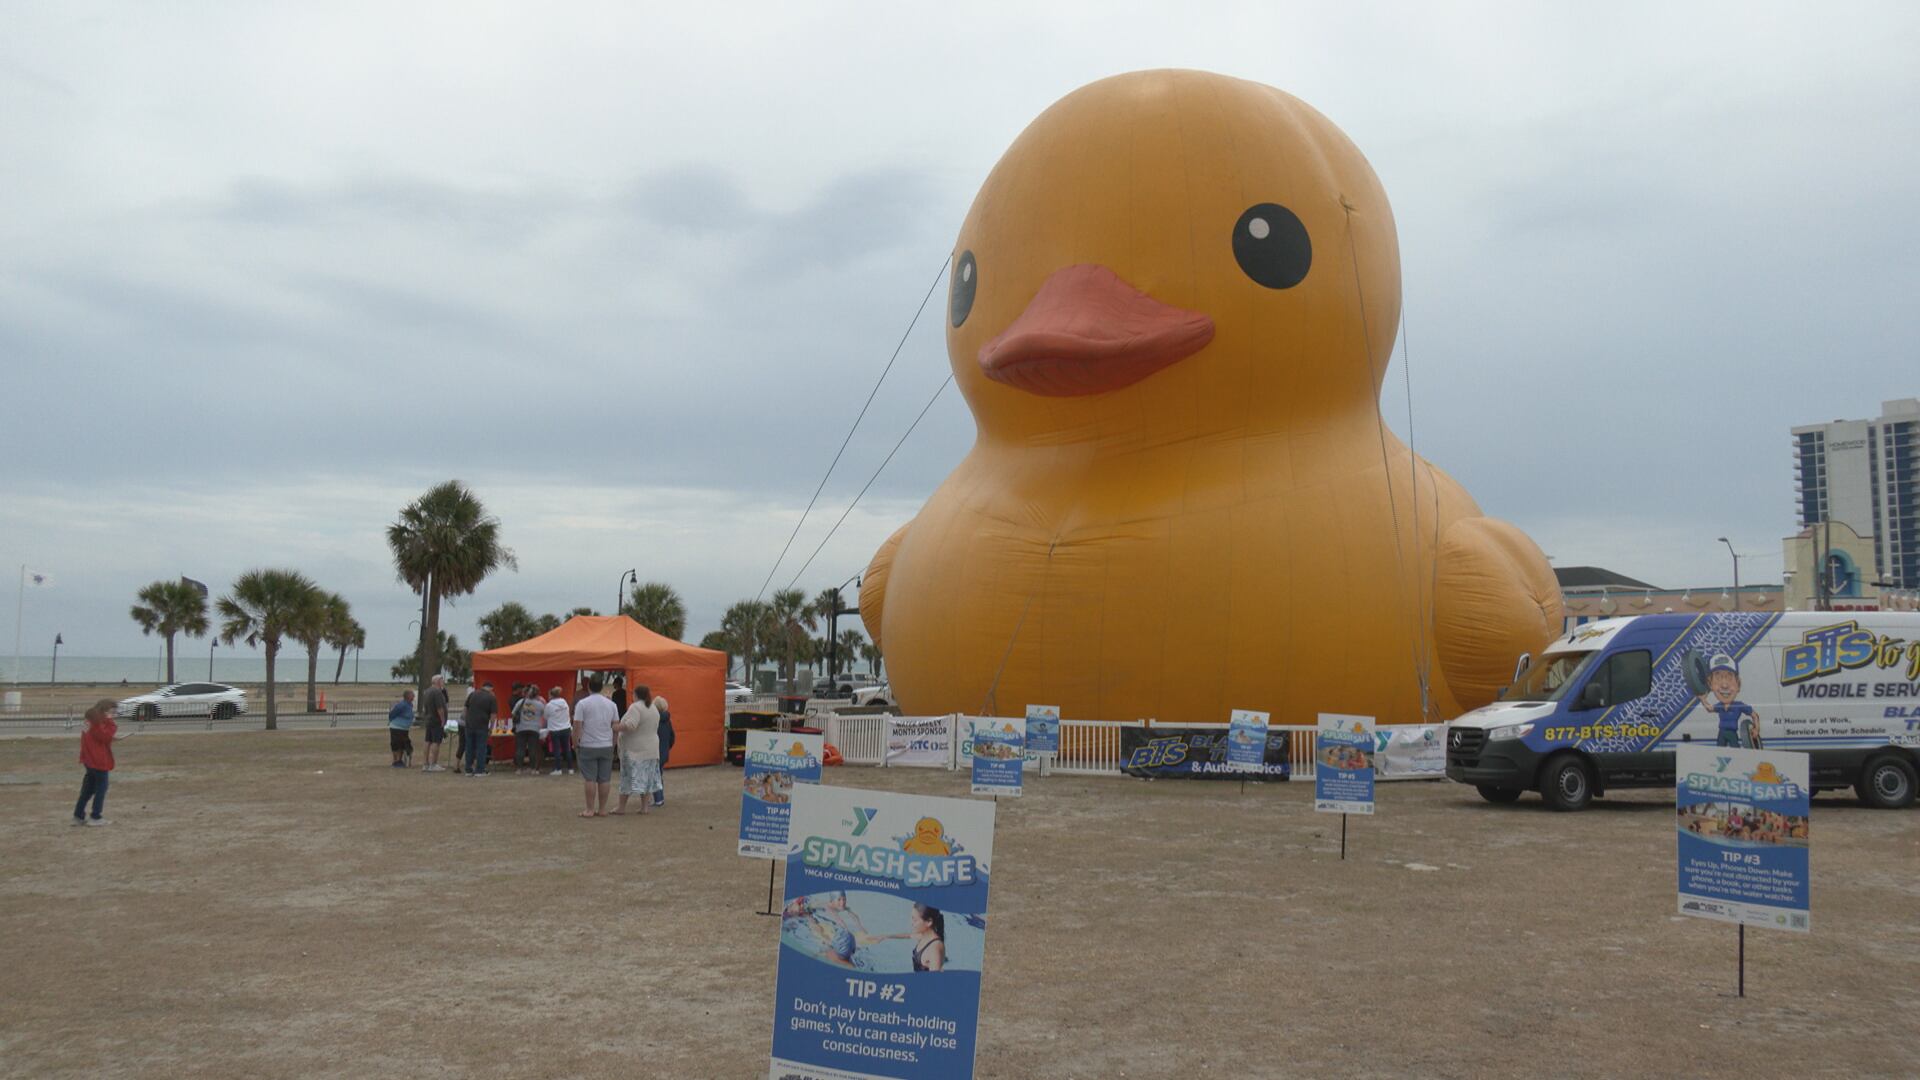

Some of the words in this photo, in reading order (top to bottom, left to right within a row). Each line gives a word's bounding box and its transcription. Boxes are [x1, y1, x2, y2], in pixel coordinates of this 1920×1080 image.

[1780, 620, 1877, 687] BTS
[1797, 683, 1868, 698] MOBILE
[752, 752, 789, 766] SPLASH
[789, 758, 816, 770] SAFE
[1128, 736, 1189, 768] BTS
[1203, 762, 1233, 773] Auto
[1688, 774, 1752, 796] SPLASH
[1754, 785, 1798, 801] SAFE
[766, 806, 779, 815] TIP
[804, 839, 904, 876] SPLASH
[908, 858, 973, 884] SAFE
[1720, 863, 1747, 873] Phones
[1721, 851, 1742, 862] TIP
[1744, 854, 1761, 865] #3
[804, 868, 824, 879] YMCA
[824, 871, 833, 880] OF
[834, 873, 864, 885] COASTAL
[864, 877, 901, 890] CAROLINA
[846, 977, 877, 999] TIP
[880, 983, 906, 1003] #2
[794, 997, 827, 1016] Don't
[829, 1003, 856, 1023] play
[858, 1007, 957, 1035] breath-holding
[790, 1017, 834, 1035] games.
[837, 1021, 862, 1038] You
[864, 1027, 888, 1041] can
[890, 1029, 928, 1051] easily
[930, 1033, 957, 1050] lose
[822, 1038, 919, 1063] consciousness.
